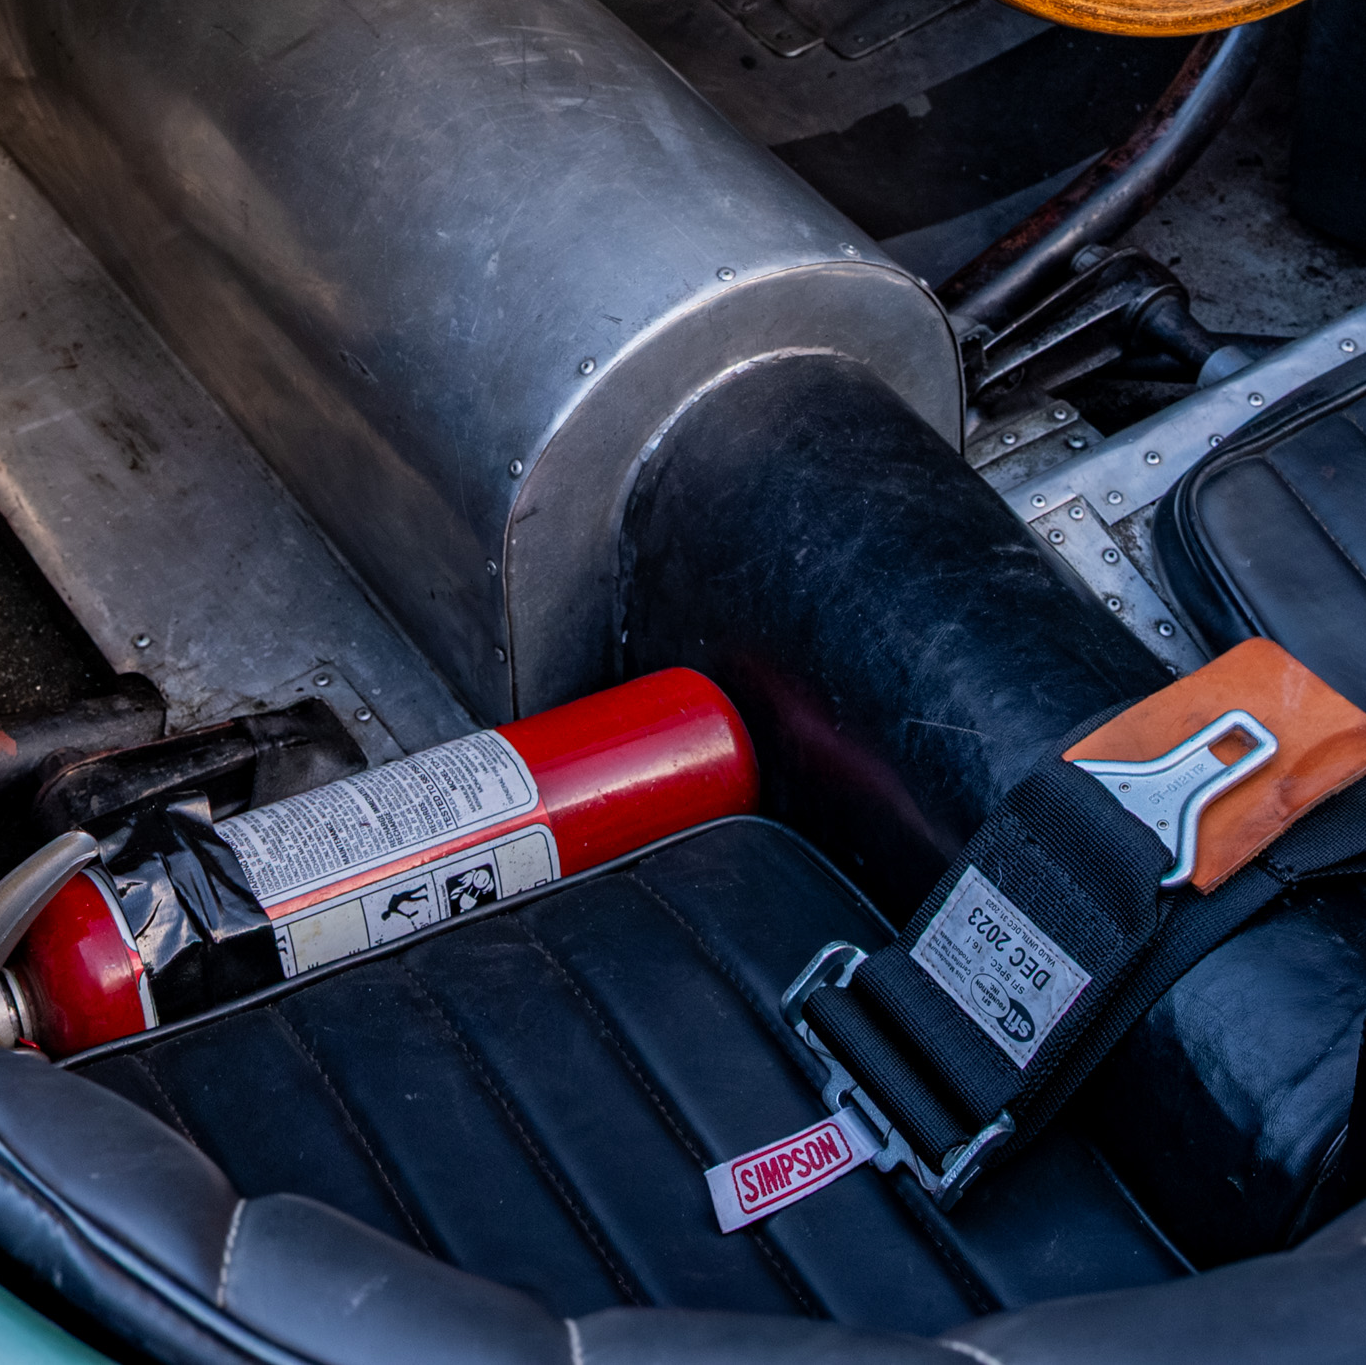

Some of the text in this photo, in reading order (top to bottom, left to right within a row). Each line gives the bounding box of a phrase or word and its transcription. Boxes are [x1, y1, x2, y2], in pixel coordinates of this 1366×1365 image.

[418, 772, 430, 784] 585
[425, 783, 437, 795] TO
[438, 768, 457, 791] MODEL
[496, 777, 514, 804] GENERAL
[440, 785, 451, 797] DRY
[458, 784, 476, 813] MAXIMUM
[354, 785, 397, 848] RECHARGE IMMEDIATELY
[410, 804, 430, 837] ACCORDANCE
[431, 793, 454, 828] TESTED
[285, 828, 299, 845] RESULT
[294, 843, 304, 855] MAY
[310, 827, 336, 870] USE ONLY GENERAL
[315, 823, 342, 868] DISCHARGE NOZZLE
[340, 835, 357, 863] FREQUENT
[365, 839, 376, 855] THAT
[265, 846, 277, 862] LEVER
[268, 838, 295, 885] PARTIAL DISCHARGE
[291, 852, 308, 880] RECHARGE
[298, 835, 322, 875] RECHARGE ONLY
[240, 859, 261, 898] WARNING
[274, 863, 288, 888] SQUEEZE
[283, 851, 301, 883] FUNCTIONAL
[254, 870, 269, 895] GENERAL
[985, 898, 1000, 913] 2023
[1007, 920, 1022, 936] DEC
[939, 931, 971, 965] Product Meets
[941, 947, 955, 961] That
[967, 906, 1052, 991] DEC 2023
[1021, 932, 1039, 951] UNTIL
[953, 957, 972, 977] Certifies
[990, 956, 1011, 981] SPEC.
[1038, 949, 1056, 968] VALID
[955, 971, 967, 984] This
[989, 982, 1000, 995] INC.
[1010, 979, 1026, 995] SFI
[975, 979, 1007, 1011] FOUNDATION
[981, 995, 992, 1007] SFI
[1003, 1008, 1033, 1038] sfi
[740, 1131, 841, 1203] SIMPSON
